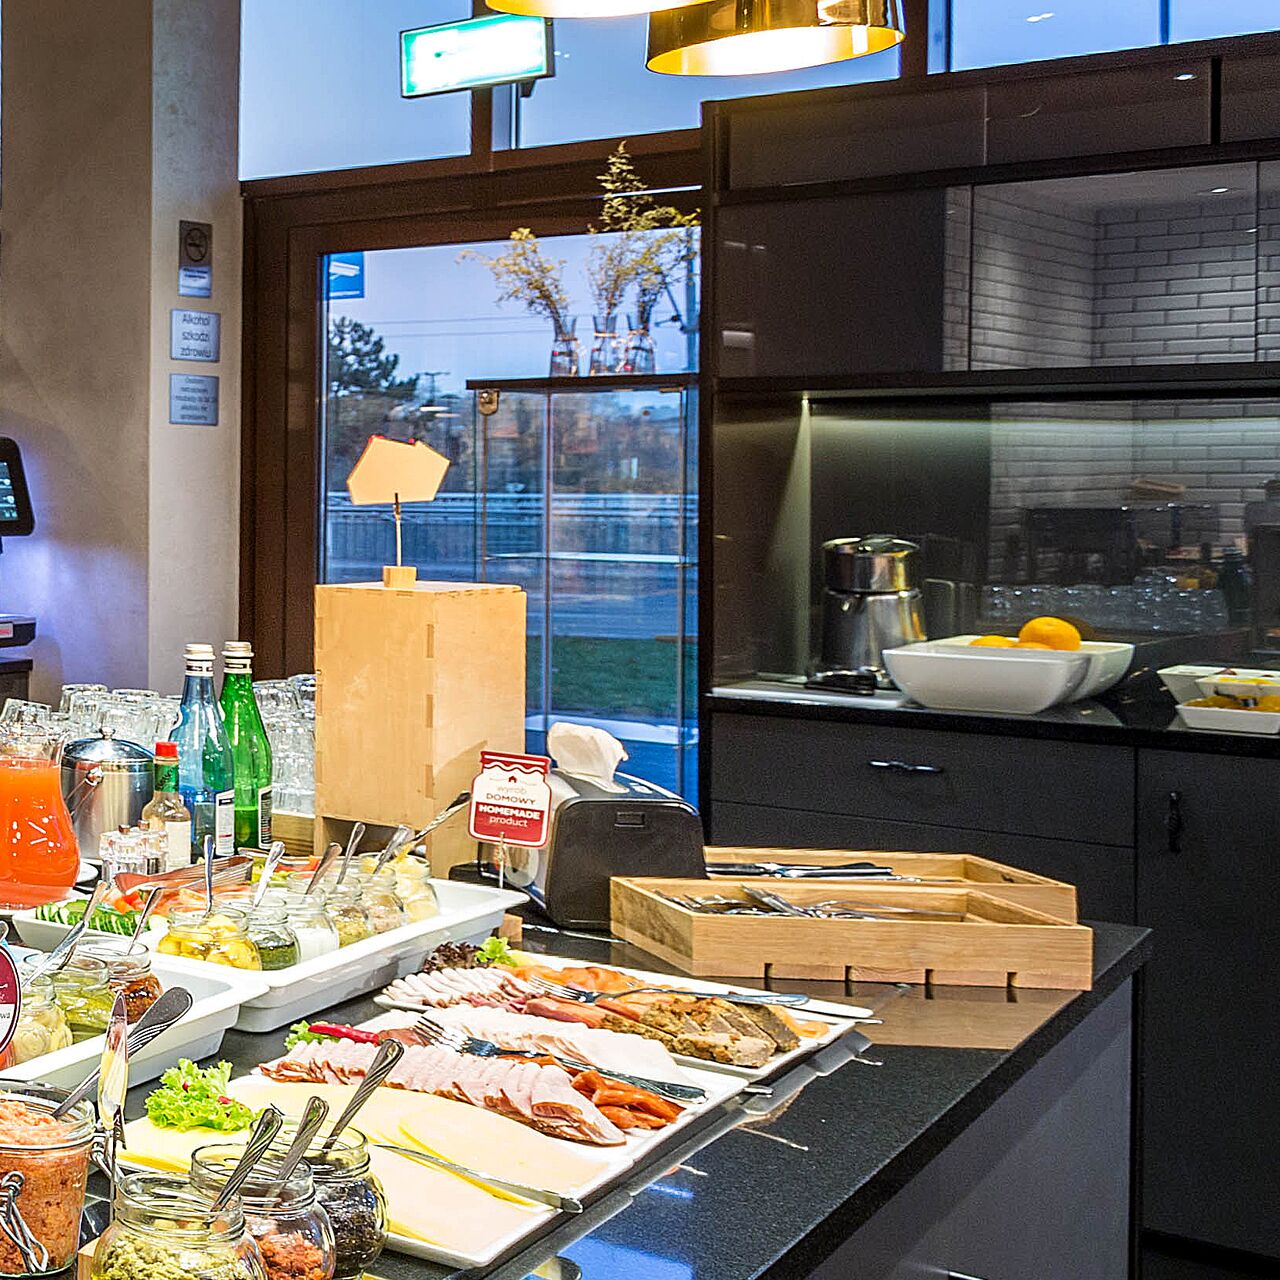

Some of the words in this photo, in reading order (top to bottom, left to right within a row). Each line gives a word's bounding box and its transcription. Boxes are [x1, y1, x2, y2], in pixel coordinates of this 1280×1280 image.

[486, 793, 536, 805] DOMOWY
[478, 804, 541, 820] HOMEMADE
[489, 816, 528, 828] product
